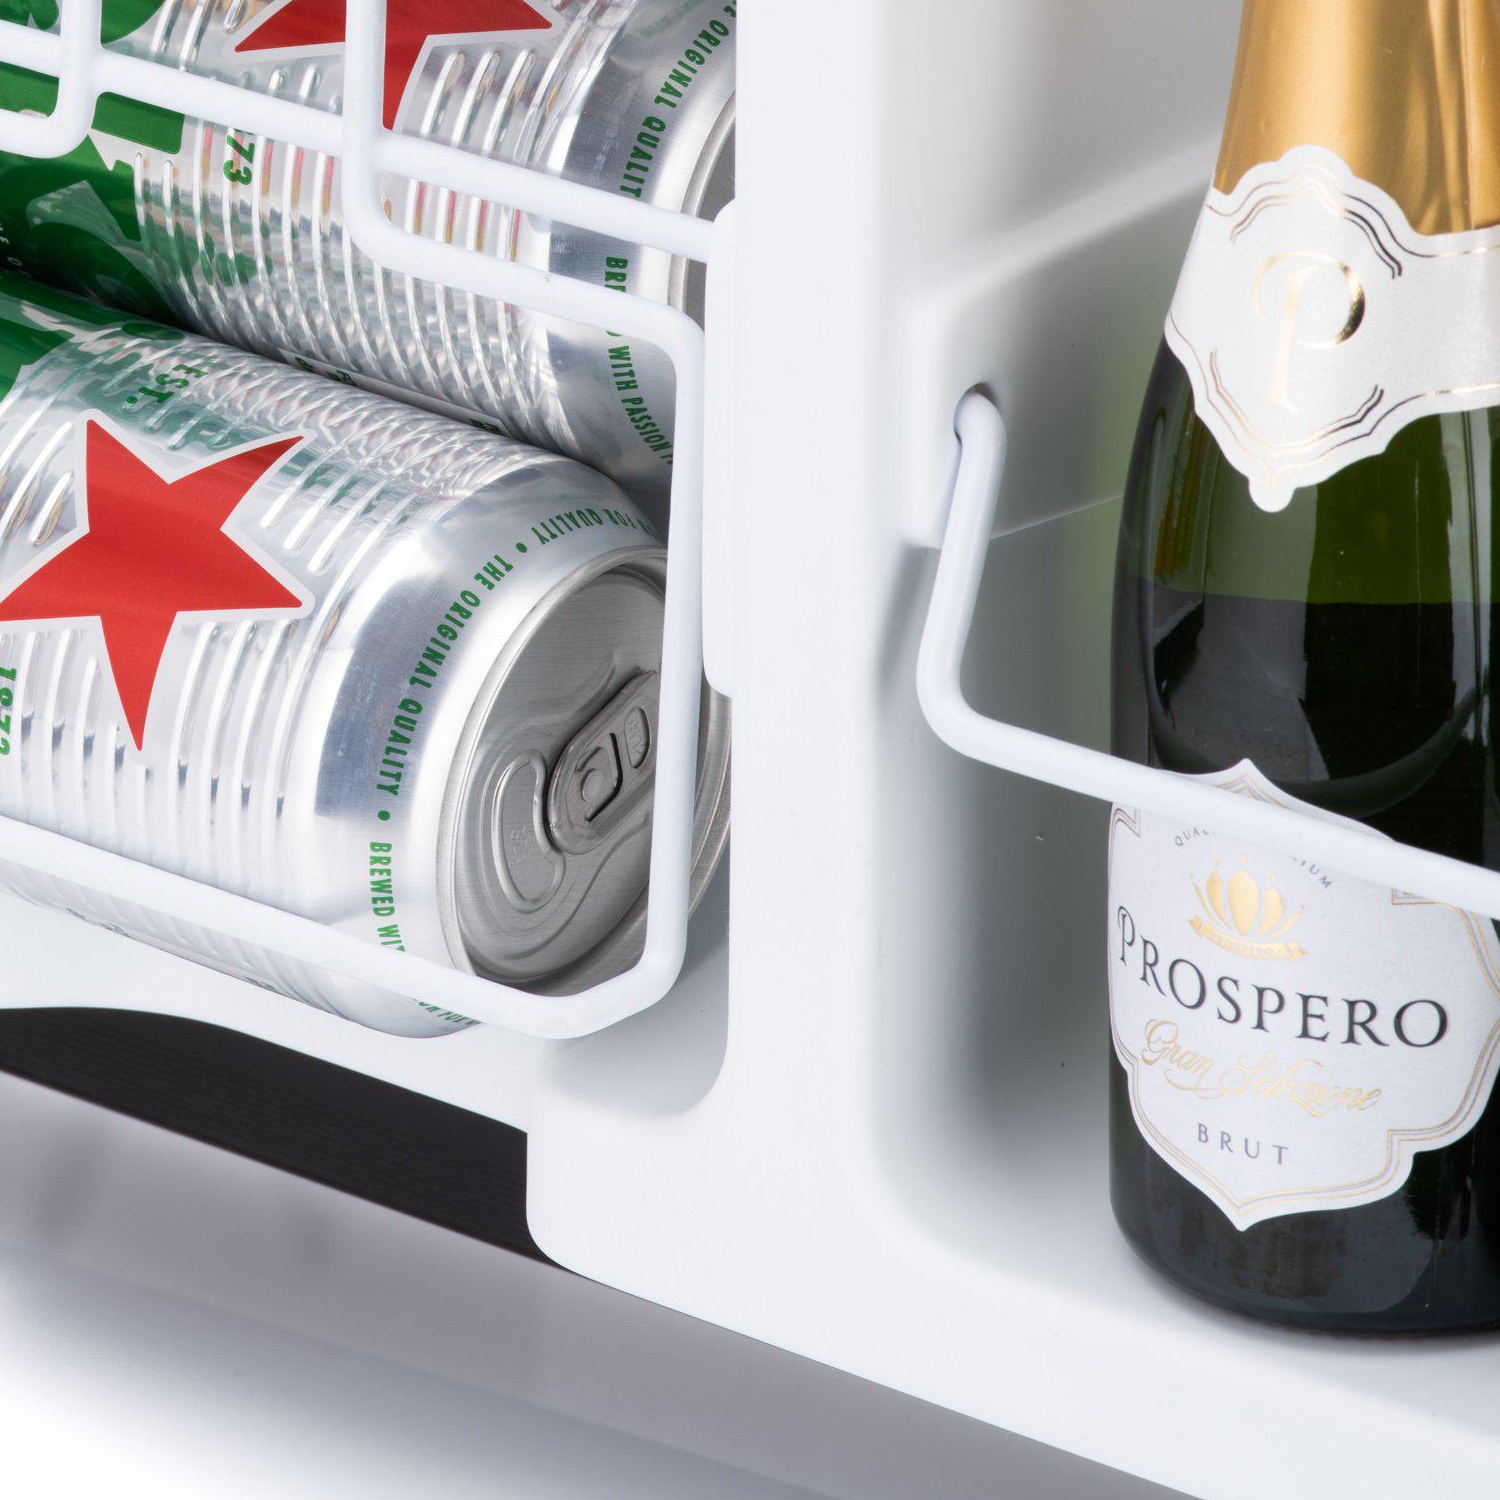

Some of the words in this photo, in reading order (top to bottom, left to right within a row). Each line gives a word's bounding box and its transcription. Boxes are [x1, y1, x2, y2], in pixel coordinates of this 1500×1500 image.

[654, 17, 729, 108] ORIGINAL
[223, 128, 253, 186] 73
[619, 116, 666, 198] QUALIT
[1251, 250, 1366, 412] P
[125, 363, 208, 404] EST.
[608, 345, 636, 391] WITH
[622, 397, 671, 460] PASSION
[486, 554, 514, 591] THE
[409, 590, 481, 688] ORIGINAL
[376, 697, 422, 809] QUALITY
[369, 842, 394, 917] BREWED
[1117, 905, 1449, 1048] PROSPERO
[1198, 1122, 1290, 1165] BRUT
